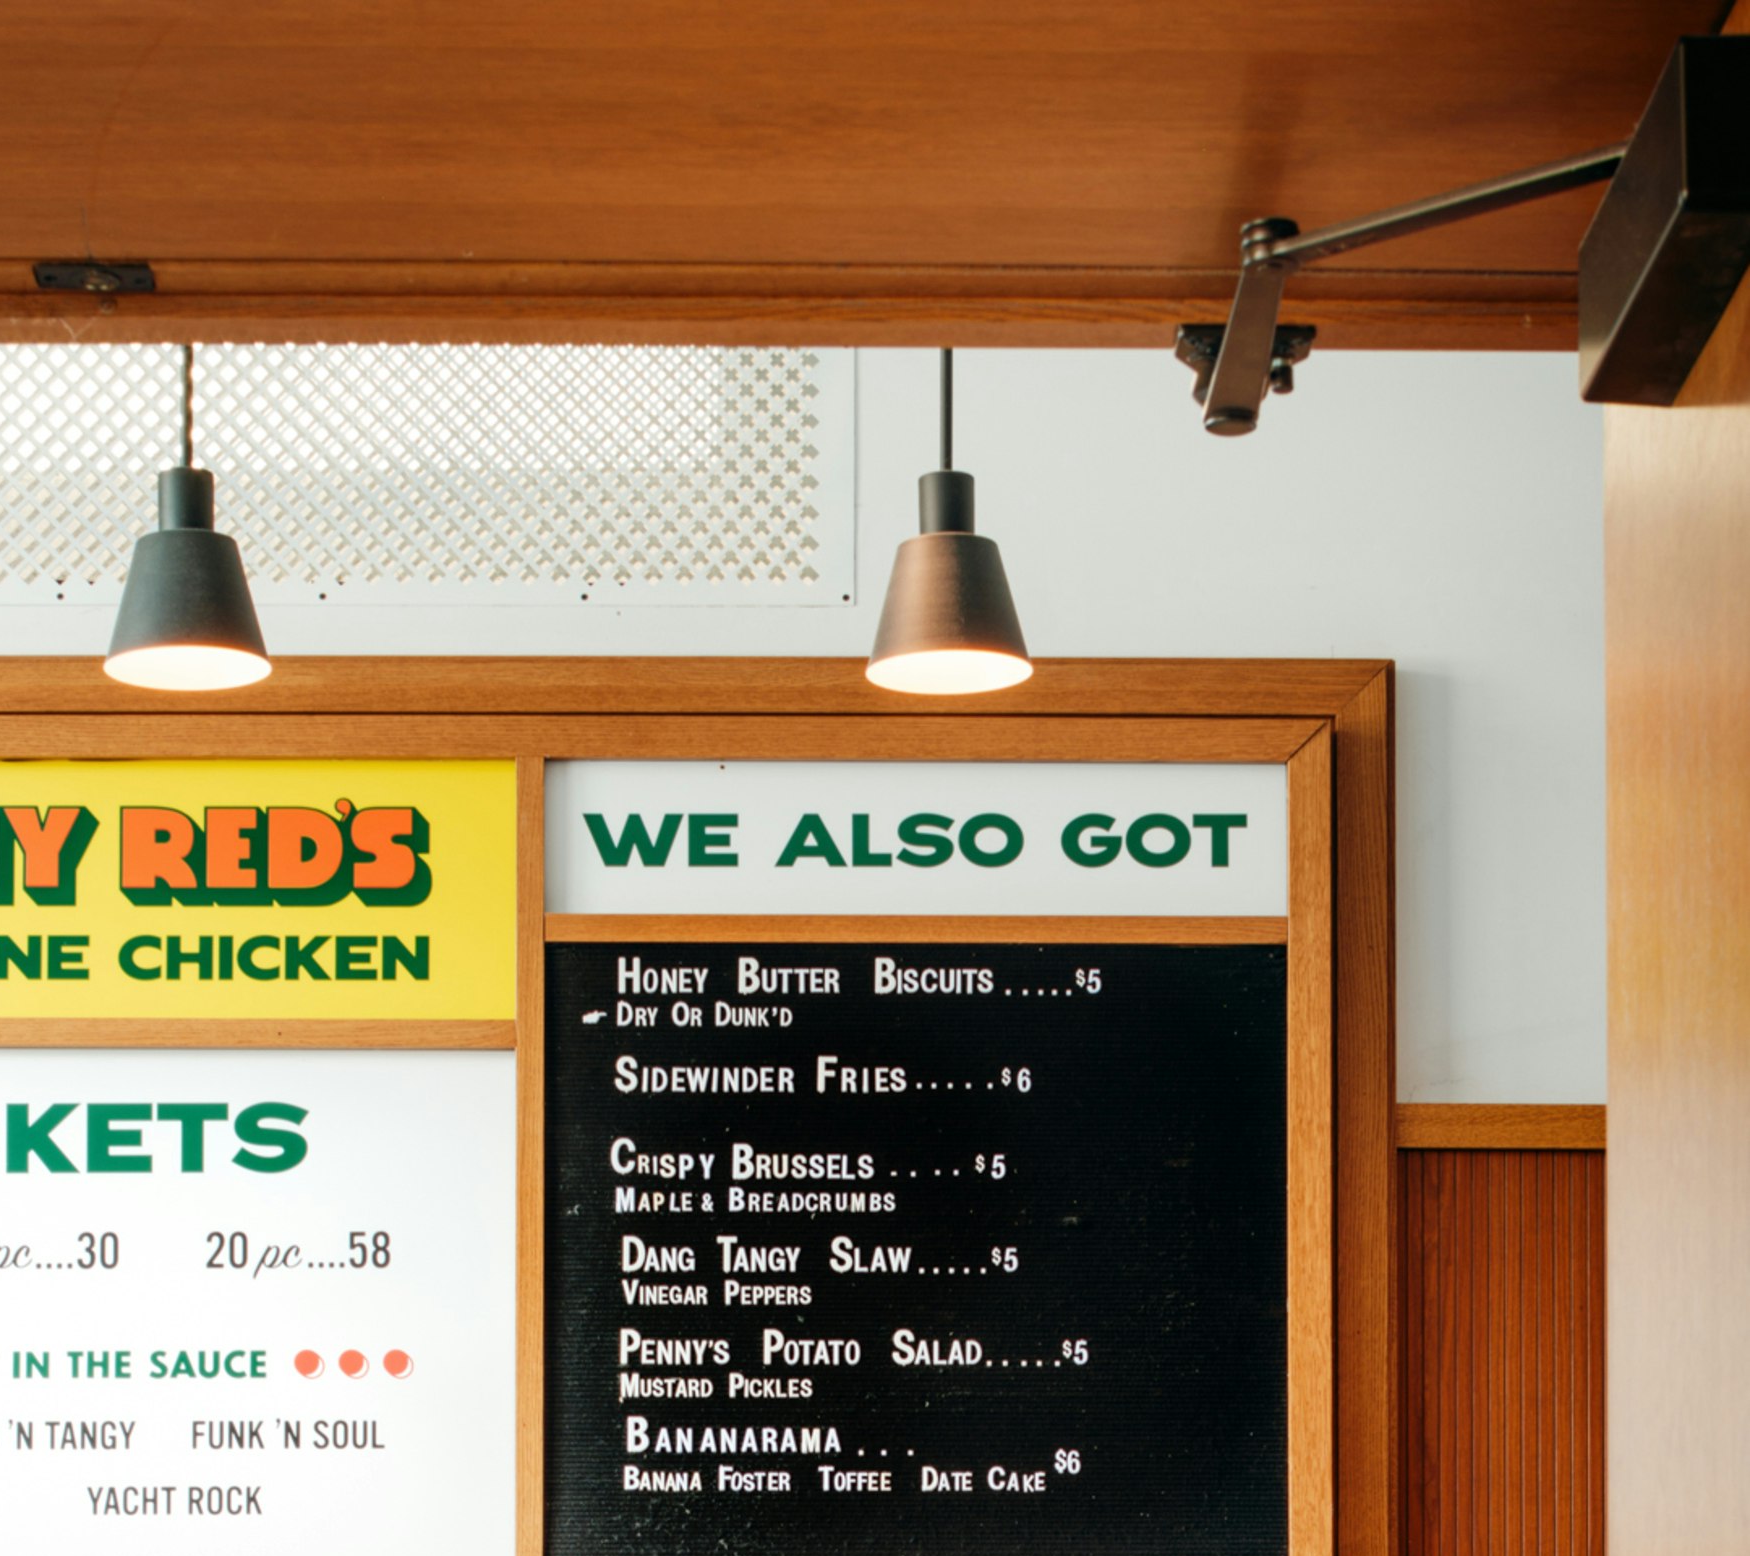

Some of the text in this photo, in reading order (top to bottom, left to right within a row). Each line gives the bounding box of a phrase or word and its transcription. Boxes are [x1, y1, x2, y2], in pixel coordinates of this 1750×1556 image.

[118, 797, 434, 908] RED'S
[583, 813, 1247, 868] WE ALSO GOT
[119, 935, 429, 981] CHICKEN
[1002, 1068, 1031, 1092] $6
[207, 1232, 247, 1268] 20
[13, 1352, 49, 1378] IN
[68, 1351, 131, 1378] THE
[150, 1350, 266, 1378] SAUCE
[45, 1421, 135, 1449] TANGY
[193, 1421, 264, 1449] FUNK
[314, 1420, 384, 1449] SOUL
[1054, 1449, 1081, 1474] $6
[88, 1486, 261, 1515] YACHT ROCK
